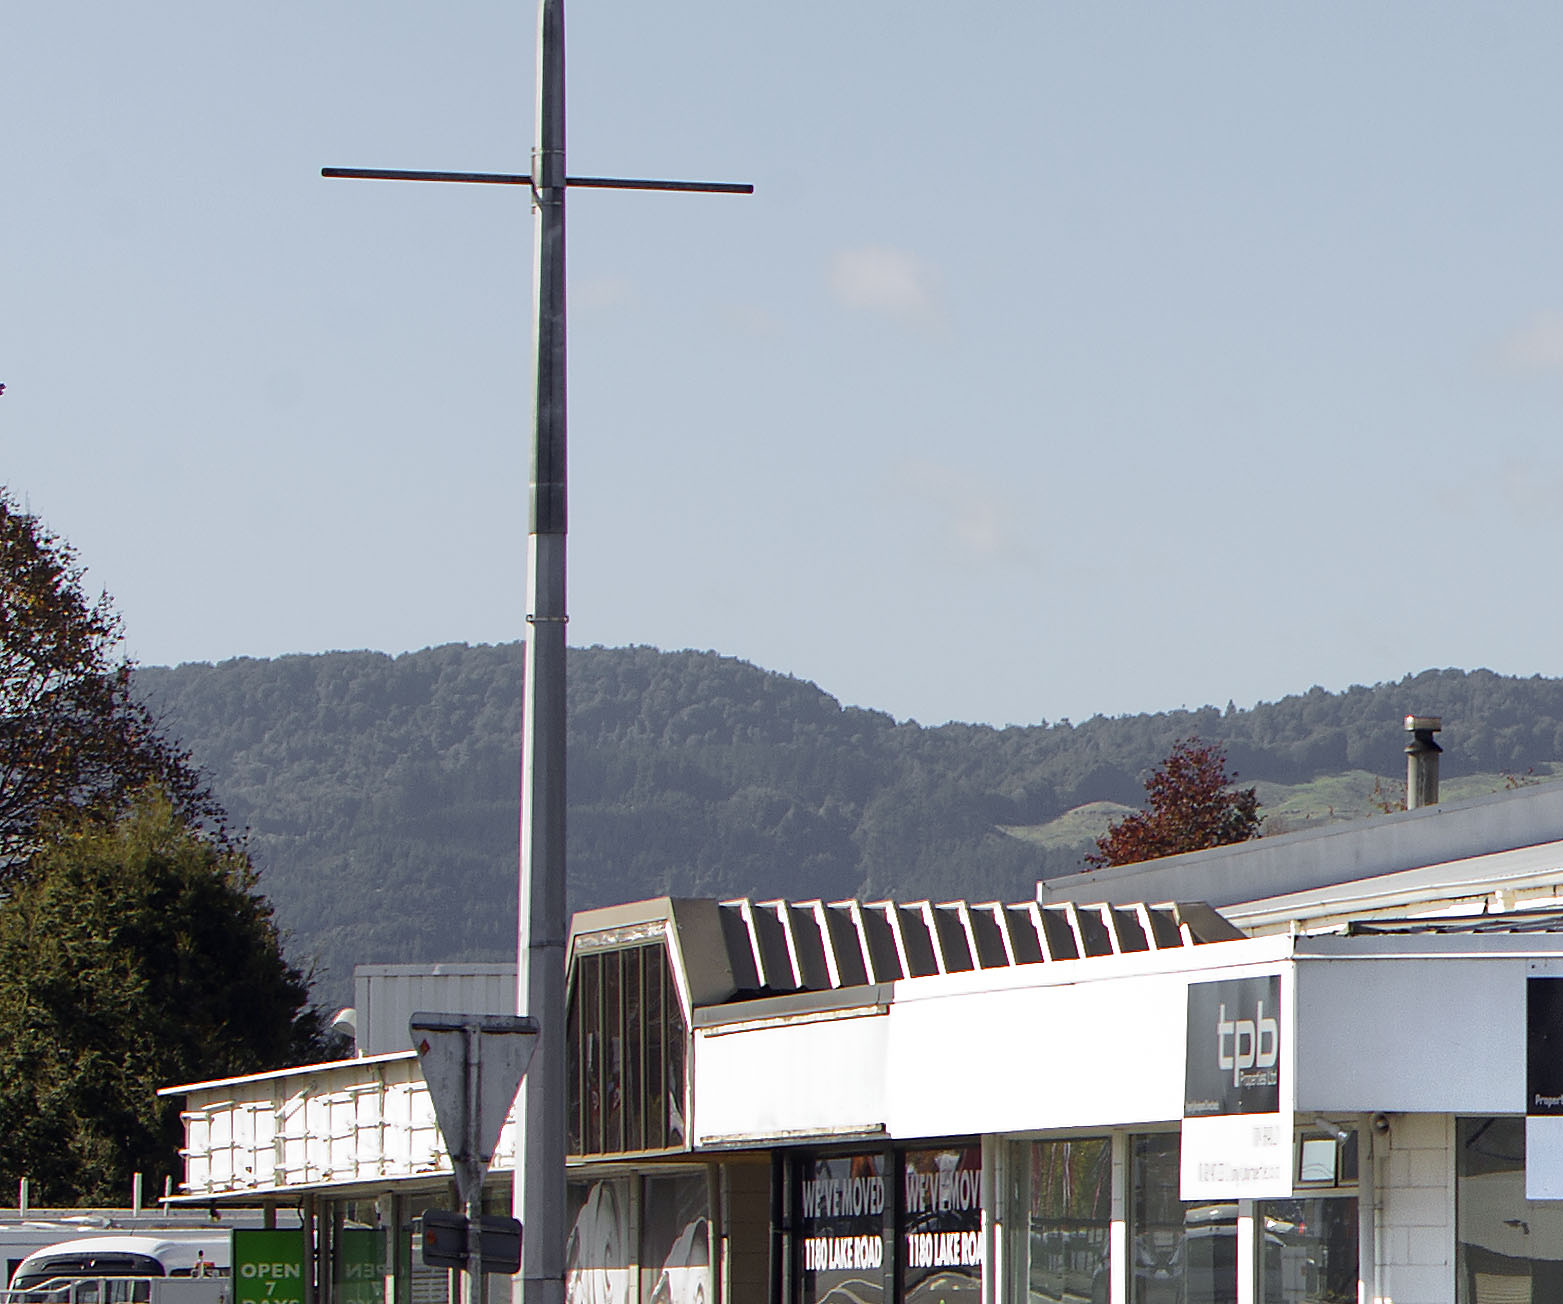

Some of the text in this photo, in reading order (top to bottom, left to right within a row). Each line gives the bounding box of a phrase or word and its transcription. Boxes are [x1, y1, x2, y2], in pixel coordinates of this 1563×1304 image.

[1217, 1000, 1278, 1088] tpb
[802, 1176, 885, 1218] WE'VE MOVED
[905, 1169, 982, 1214] WE'VE MOV
[805, 1235, 884, 1271] 1180 LAKE ROAD
[908, 1231, 983, 1268] 1180 LAKE ROA
[240, 1263, 300, 1278] OPEN
[265, 1282, 276, 1296] 7
